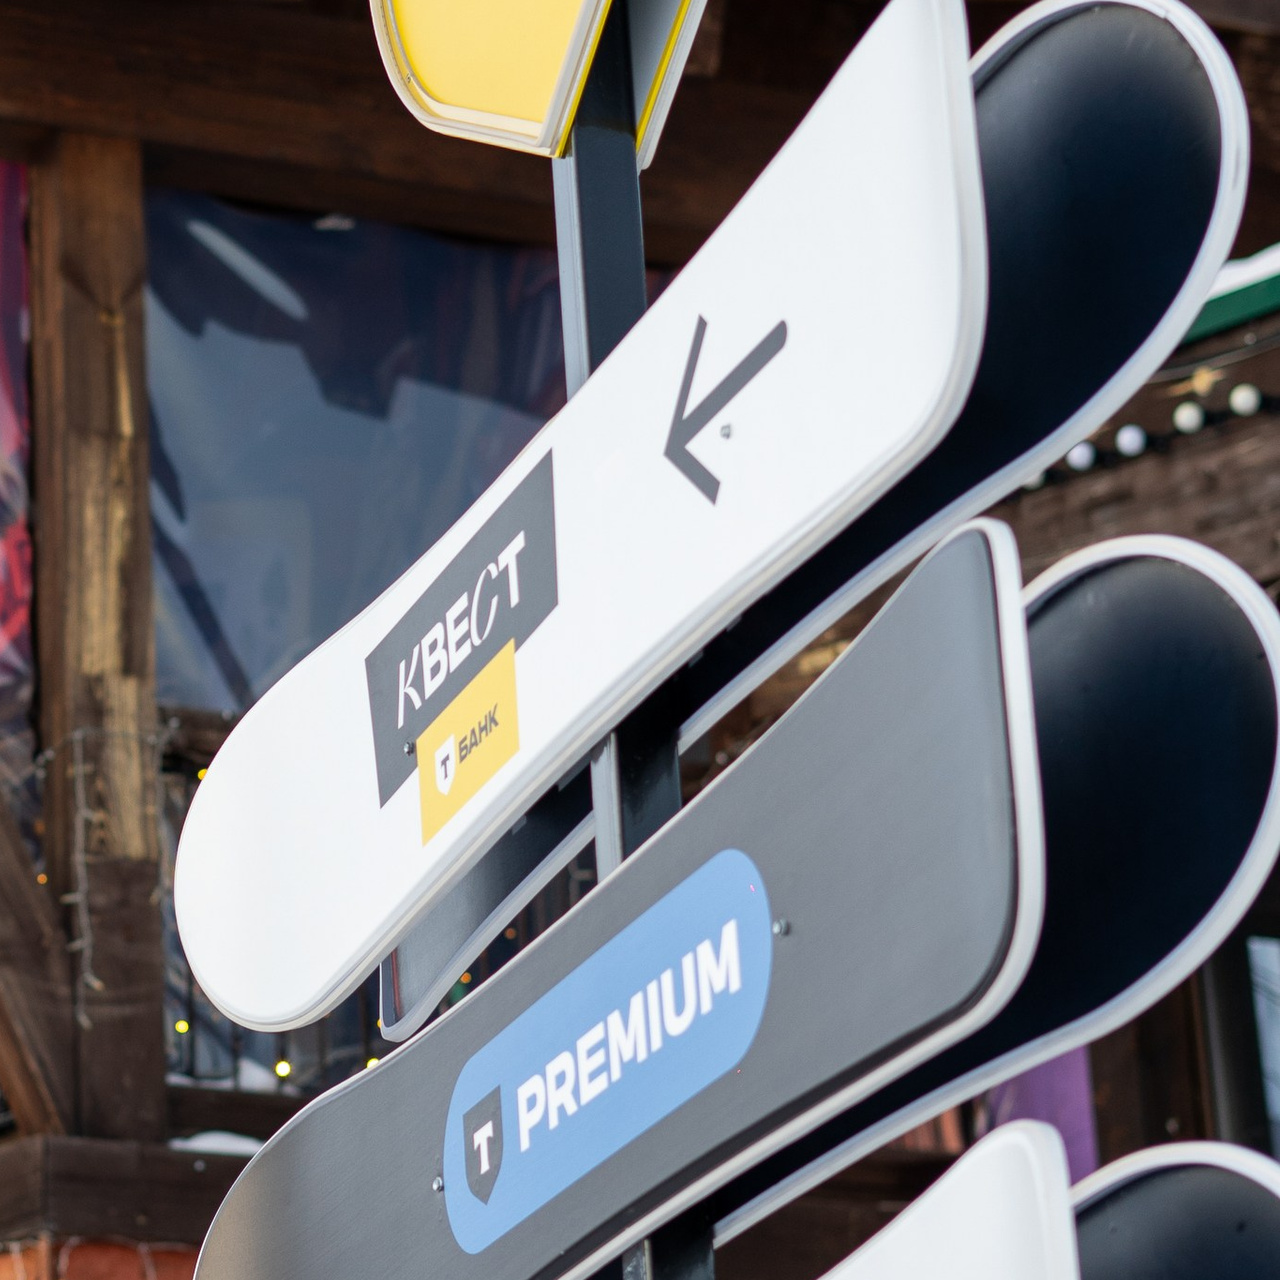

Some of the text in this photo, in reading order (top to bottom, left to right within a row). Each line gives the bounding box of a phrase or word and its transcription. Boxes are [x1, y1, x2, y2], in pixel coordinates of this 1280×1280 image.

[397, 530, 526, 729] КВЕСТ
[458, 702, 499, 764] БАНК
[517, 918, 742, 1153] PREMIUM
